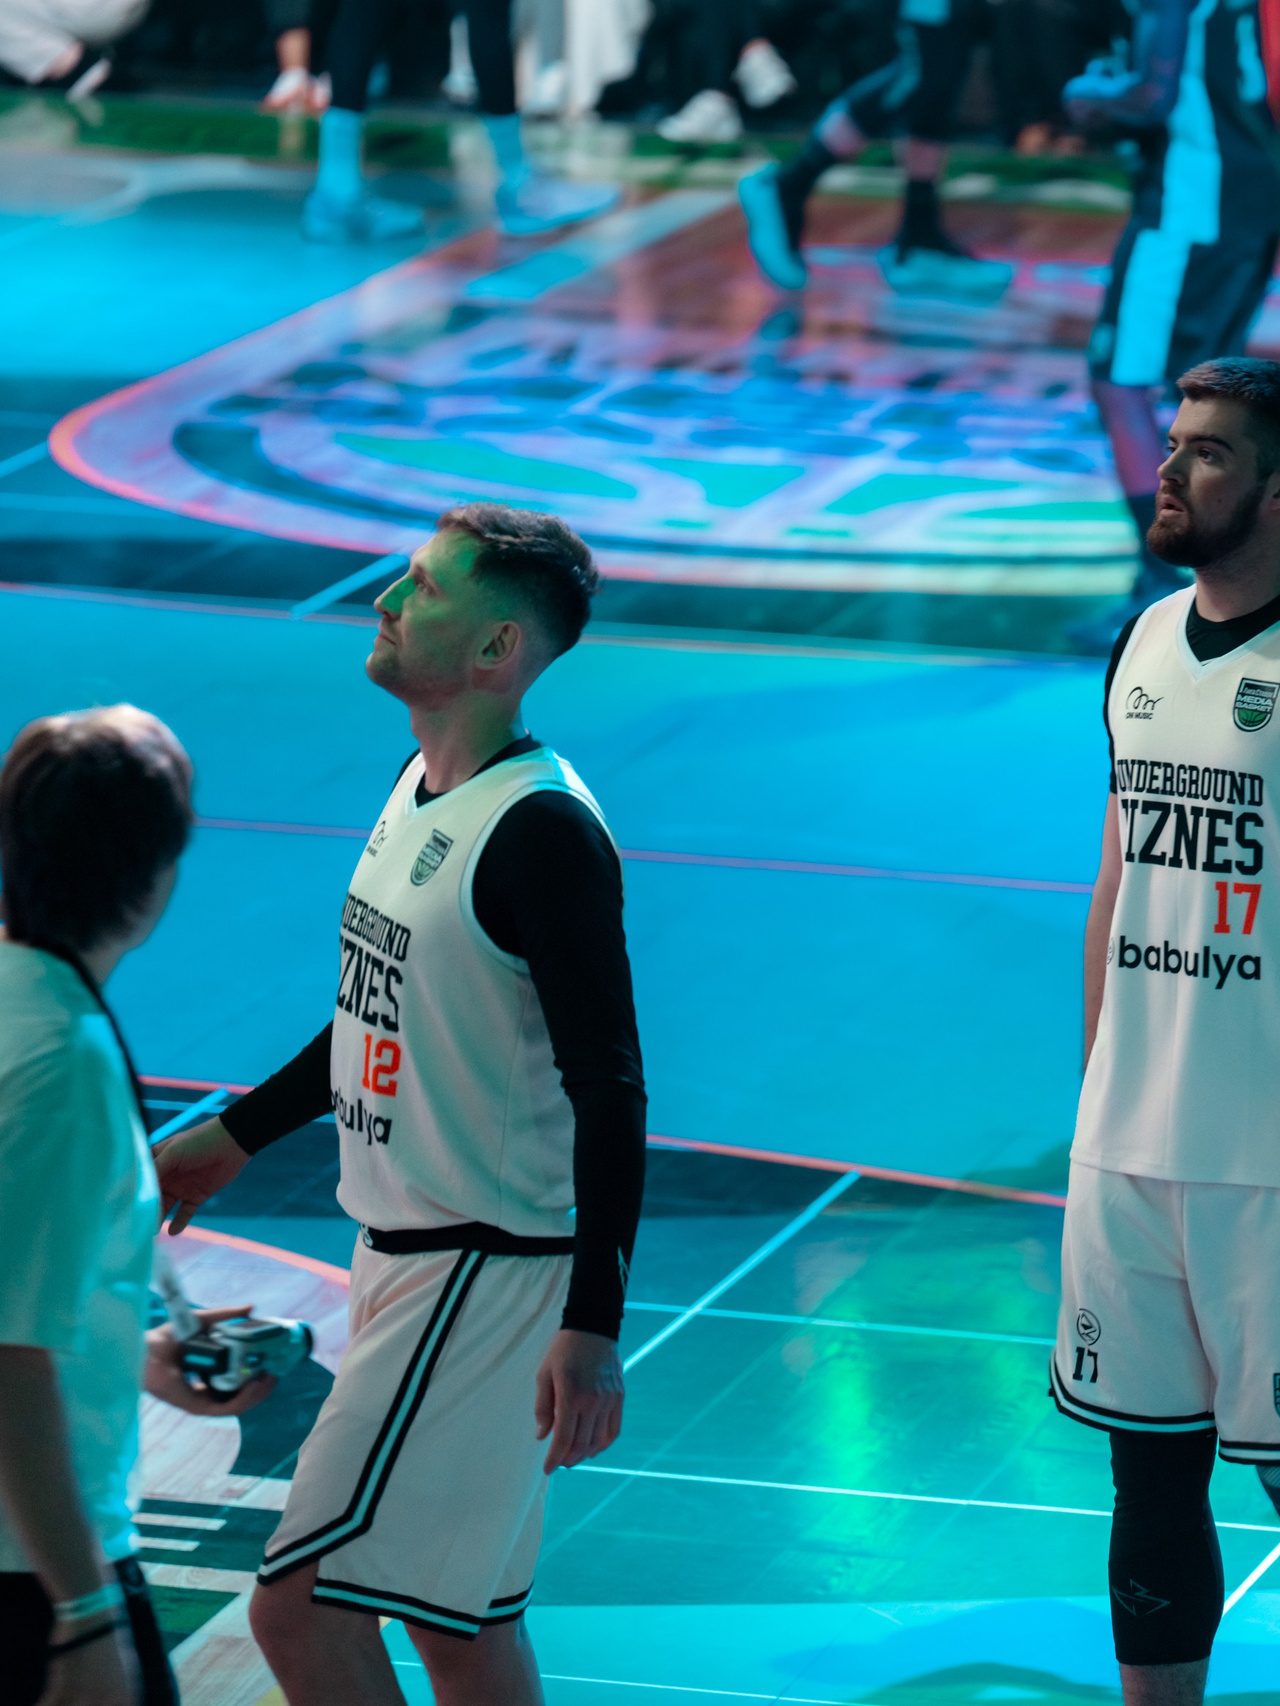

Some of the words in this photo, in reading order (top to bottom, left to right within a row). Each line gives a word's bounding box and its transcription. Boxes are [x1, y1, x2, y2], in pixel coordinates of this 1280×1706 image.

[1236, 693, 1274, 707] MEDIA
[1121, 798, 1264, 876] IZNES
[341, 892, 411, 962] DERGROUND
[1213, 880, 1262, 935] 17
[336, 935, 403, 1033] ZNES
[1118, 935, 1261, 989] babulya
[362, 1032, 402, 1097] 12
[1072, 1346, 1098, 1383] 17
